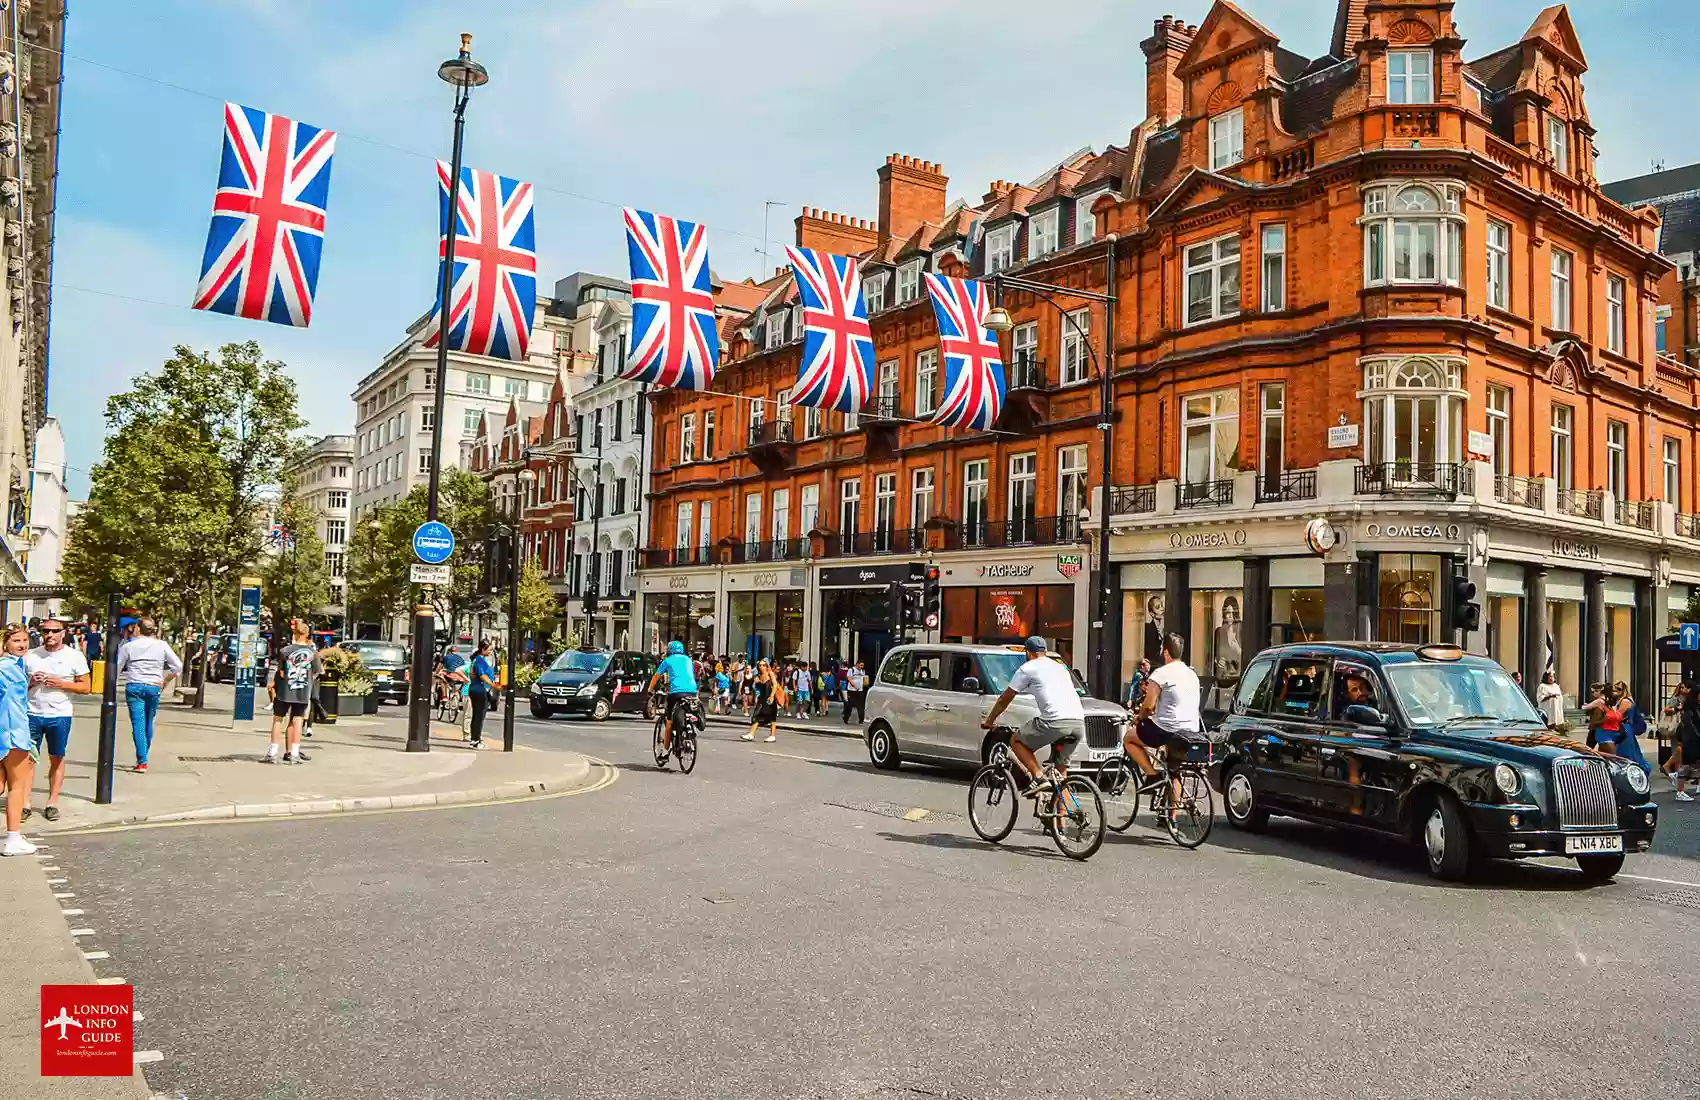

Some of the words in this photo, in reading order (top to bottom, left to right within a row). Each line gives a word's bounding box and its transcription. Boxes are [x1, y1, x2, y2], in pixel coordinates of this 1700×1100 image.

[1386, 525, 1442, 538] OMEGA
[1184, 532, 1228, 548] OMEGA
[1562, 542, 1591, 559] OMEGA
[860, 570, 876, 581] dyson
[1060, 564, 1080, 576] HEUER
[670, 576, 688, 588] ecco
[754, 572, 778, 586] ecco
[996, 605, 1016, 616] GRAY
[997, 612, 1014, 625] MAN
[1573, 837, 1596, 849] LN14
[1600, 837, 1618, 849] XBC
